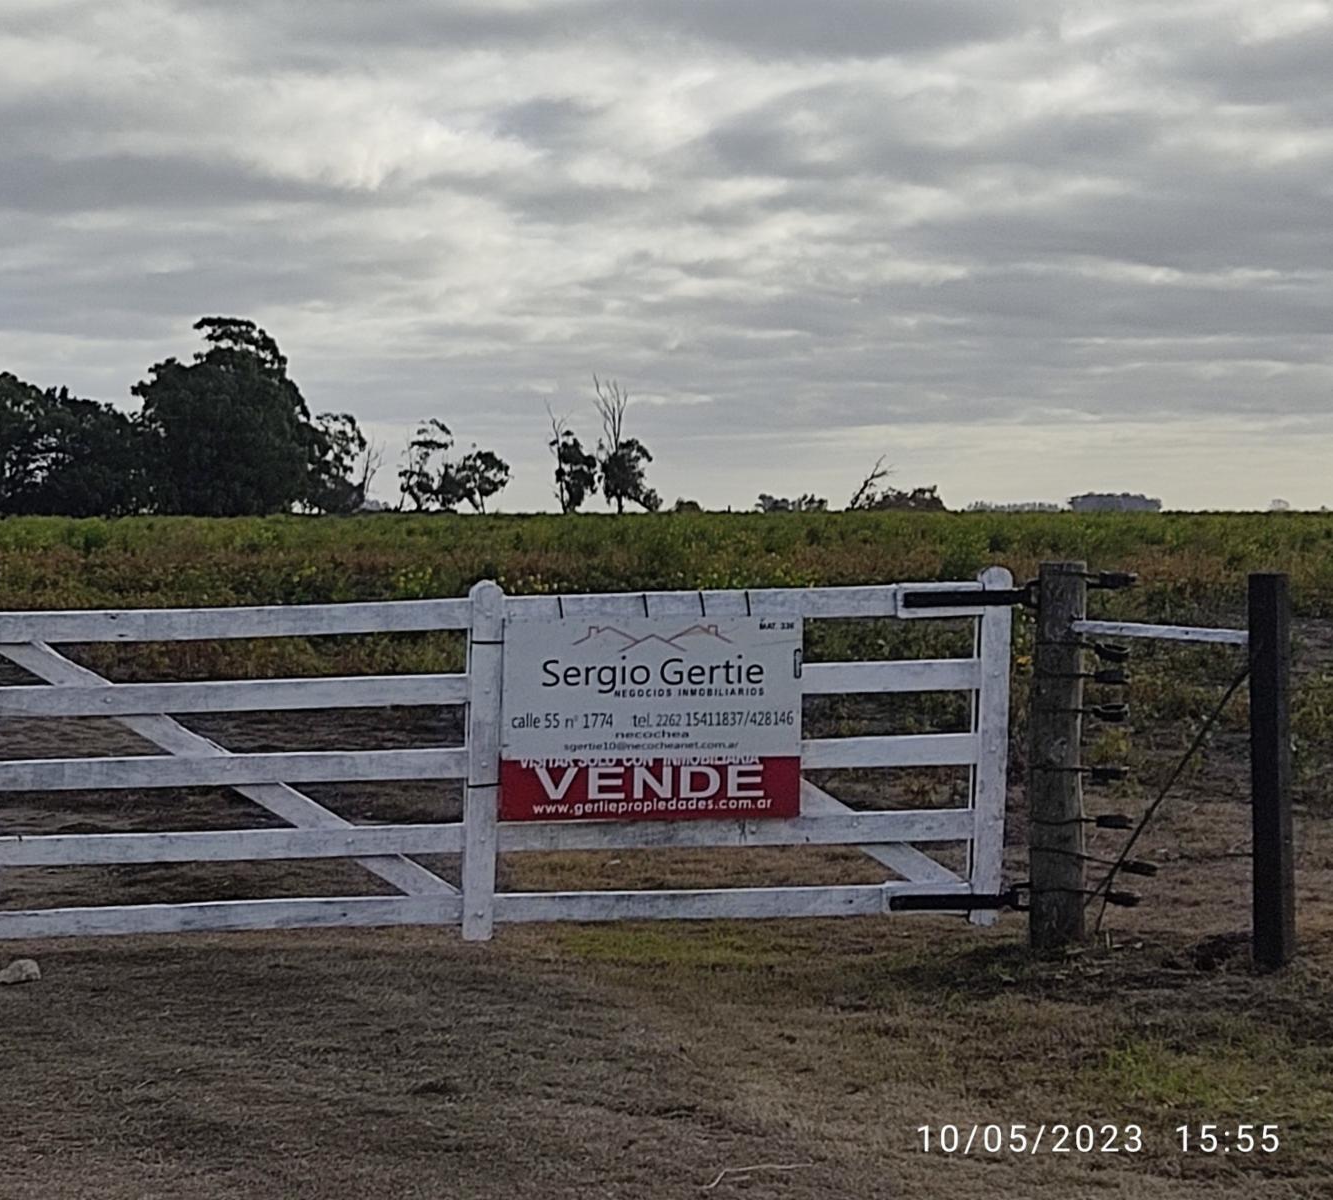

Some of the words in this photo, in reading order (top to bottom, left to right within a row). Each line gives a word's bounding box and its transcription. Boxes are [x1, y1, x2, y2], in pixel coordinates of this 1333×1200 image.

[542, 655, 651, 694] Sergio
[660, 654, 765, 686] Gertie
[615, 688, 673, 698] NEGOCIOS
[678, 687, 765, 697] INMOBILIARIOS
[511, 713, 541, 729] calle
[544, 713, 560, 728] 55
[583, 713, 613, 729] 1774
[633, 712, 652, 728] tel.
[656, 714, 682, 727] 2262
[685, 710, 794, 727] 15411837/428146
[615, 730, 689, 738] necochea
[535, 765, 764, 800] VENDE
[532, 797, 772, 816] www.gertiepropiedades.com.ar
